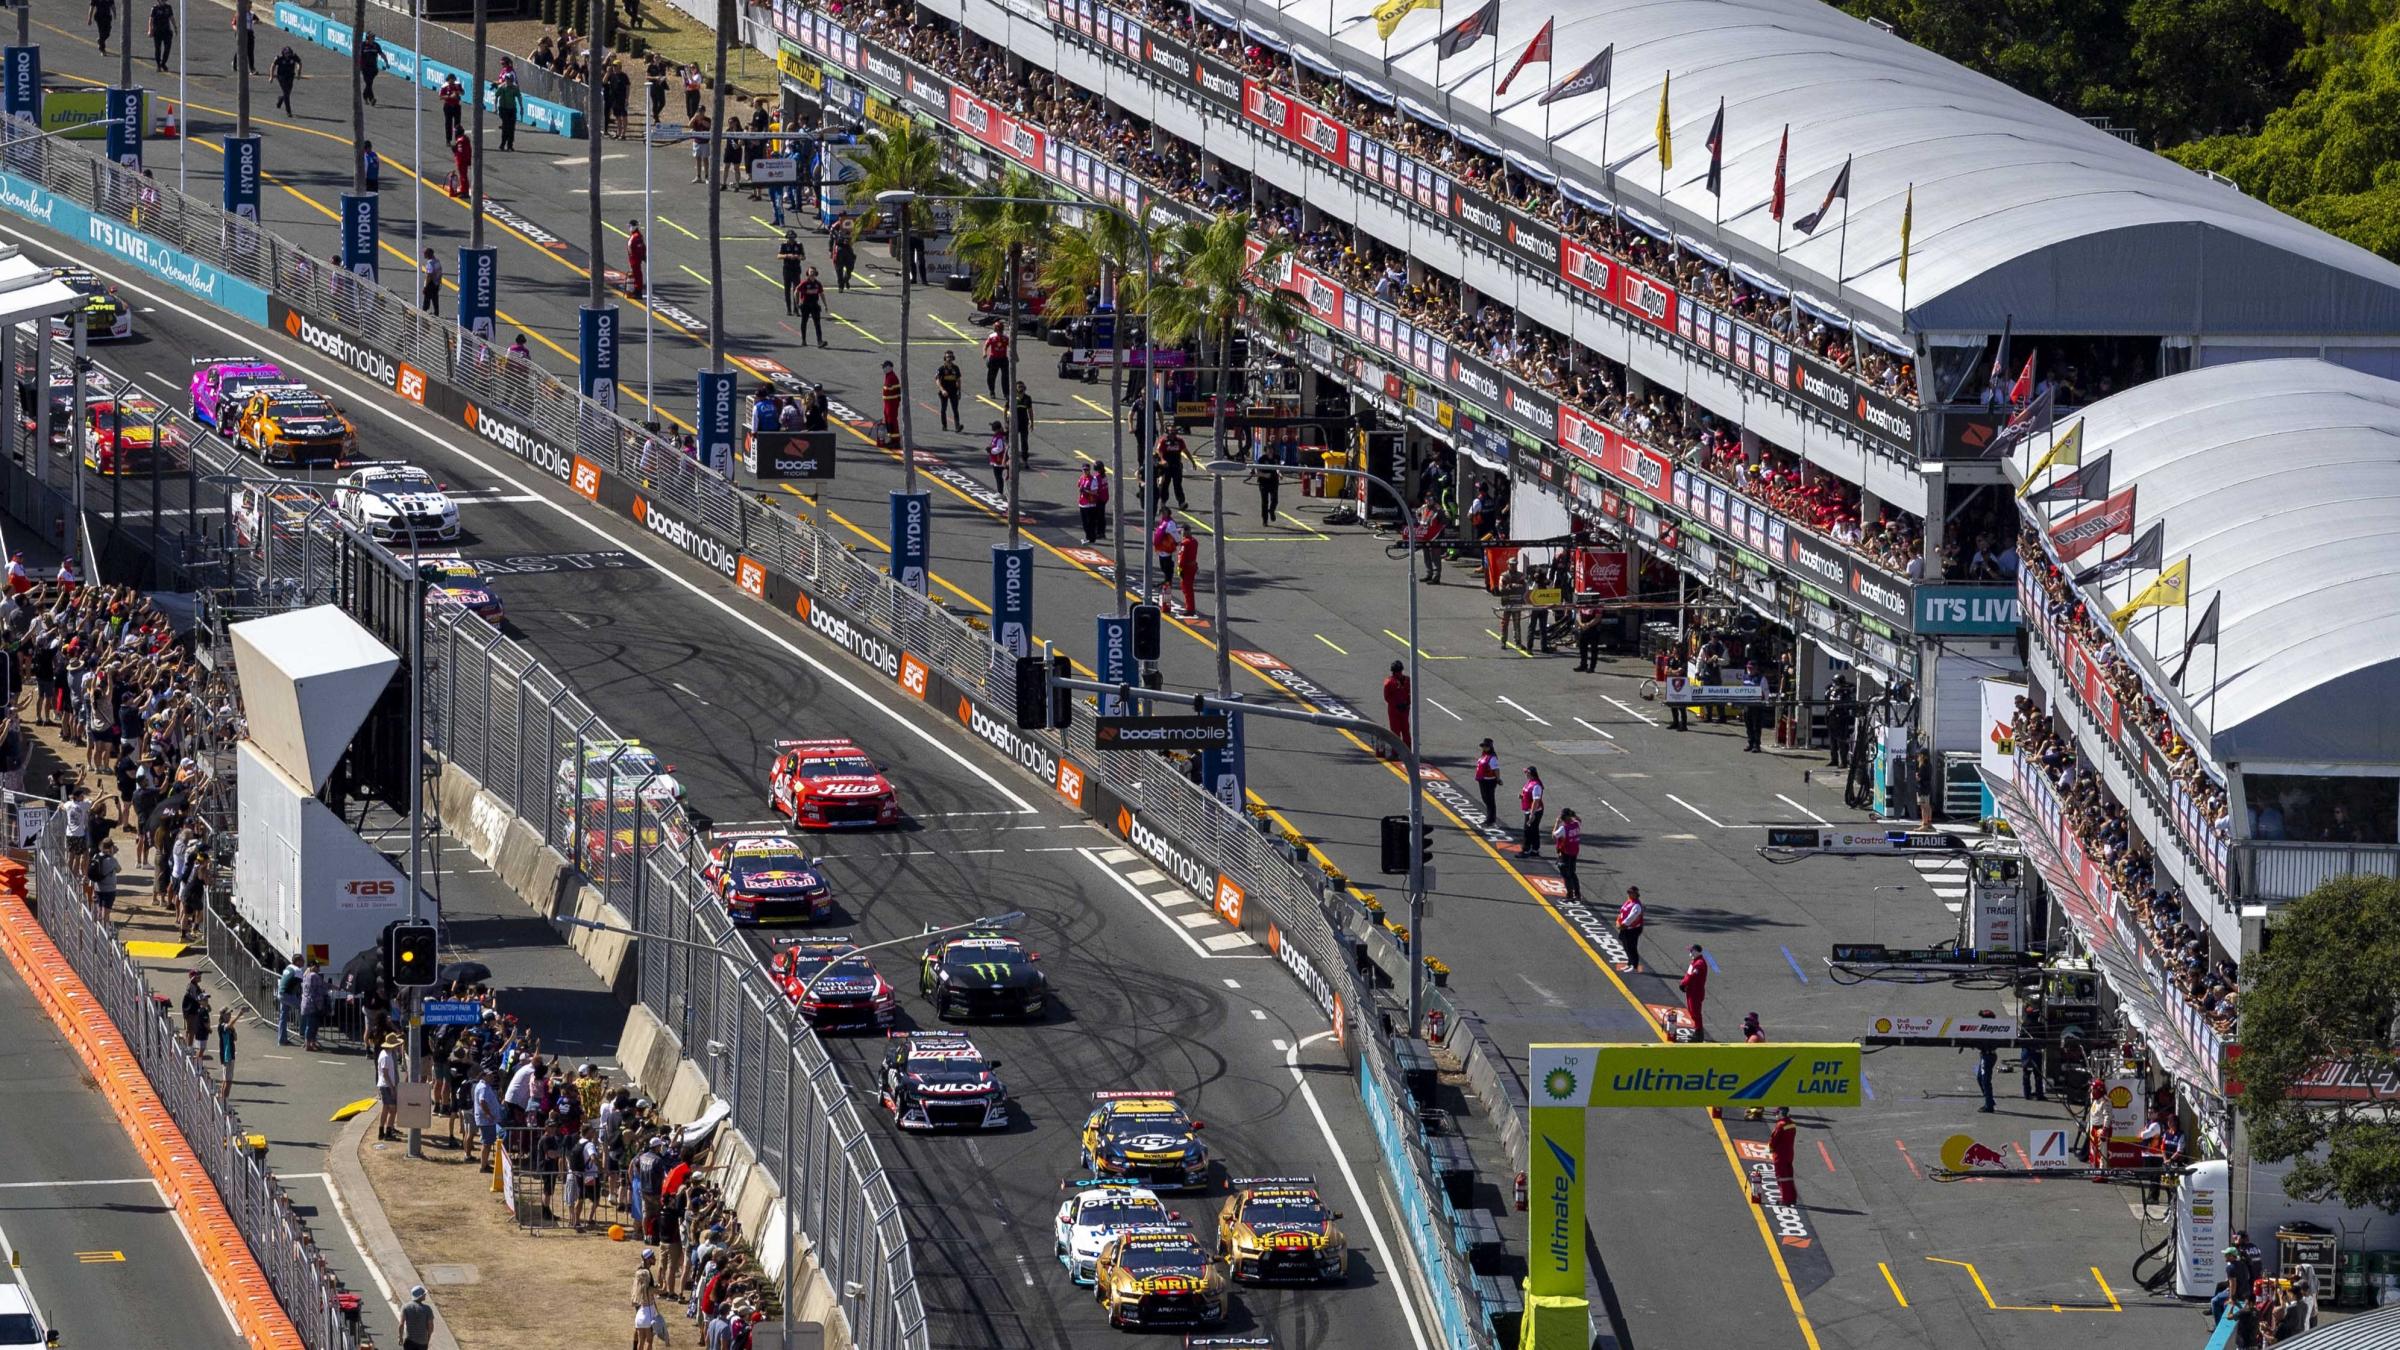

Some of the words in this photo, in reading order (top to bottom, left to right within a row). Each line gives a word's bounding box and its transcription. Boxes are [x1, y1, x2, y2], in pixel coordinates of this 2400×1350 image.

[18, 52, 30, 102] HYDRO
[786, 55, 815, 84] DUNLOP
[1153, 42, 1190, 78] boostmobile
[1202, 65, 1239, 101] boostmobile
[51, 110, 107, 123] ultimat
[124, 94, 137, 145] HYDRO
[1263, 92, 1286, 127] Repco
[1315, 117, 1338, 153] Repco
[241, 143, 253, 194] HYDRO
[357, 202, 371, 254] HYDRO
[1462, 199, 1502, 236] boostmobile
[90, 217, 113, 246] IT'S
[115, 228, 149, 264] LIVE!
[150, 252, 158, 269] in
[158, 250, 216, 297] Queensland
[1515, 225, 1557, 264] boostmobile
[477, 254, 491, 308] HYDRO
[1583, 253, 1609, 290] Repco
[1311, 277, 1335, 315] Repco
[1641, 281, 1667, 319] Repco
[301, 317, 396, 387] boostmobile
[597, 315, 611, 368] HYDRO
[400, 377, 422, 401] 5G
[1459, 362, 1498, 401] boostmobile
[1804, 370, 1849, 411] boostmobile
[716, 379, 730, 433] HYDRO
[1513, 391, 1553, 429] boostmobile
[1866, 401, 1912, 442] boostmobile
[478, 407, 571, 481] boostmobile
[1580, 419, 1605, 459] Repco
[775, 459, 818, 470] boost
[1393, 435, 1407, 482] TEAM
[1636, 450, 1662, 488] Repco
[575, 472, 595, 495] 5G
[646, 501, 736, 577] boostmobile
[907, 501, 921, 556] HYDRO
[742, 571, 760, 594] 5G
[1800, 546, 1844, 585] boostmobile
[1006, 556, 1021, 612] HYDRO
[1861, 577, 1906, 616] boostmobile
[1926, 598, 1967, 622] IT'S
[810, 604, 898, 678] boostmobile
[1108, 625, 1123, 682] HYDRO
[902, 671, 924, 694] 5G
[972, 703, 1057, 783] boostmobile
[1120, 726, 1226, 741] boostmobile
[2001, 743, 2012, 753] H
[817, 784, 881, 796] Hino
[1060, 774, 1079, 800] 5G
[1132, 814, 1214, 901] boostmobile
[1854, 836, 1886, 845] Castrol
[1910, 836, 1947, 847] TRADIE
[350, 880, 395, 896] ras
[743, 880, 782, 889] Red
[782, 878, 817, 888] Bull
[1219, 893, 1239, 918] 5G
[1985, 907, 2017, 915] TRADIE
[426, 1014, 454, 1023] COMMUNITY
[455, 1014, 475, 1022] FACILITY
[430, 1004, 459, 1012] MACINTOSH
[459, 1004, 471, 1012] PARK
[1897, 1023, 1930, 1031] V-Power
[1979, 1023, 2011, 1033] Repco
[1564, 1055, 1578, 1067] bp
[1812, 1061, 1844, 1076] PIT
[918, 1082, 992, 1092] NULON
[1613, 1068, 1739, 1092] ultimate
[1797, 1079, 1849, 1095] LANE
[1076, 1178, 1140, 1186] OPTUS
[1252, 1196, 1301, 1205] Steadfast
[1252, 1236, 1330, 1248] PENRITE
[1555, 1176, 1569, 1273] ultimate
[1130, 1241, 1181, 1249] Steadfast
[1131, 1279, 1209, 1292] PENRITE
[1192, 1335, 1271, 1346] erebus
